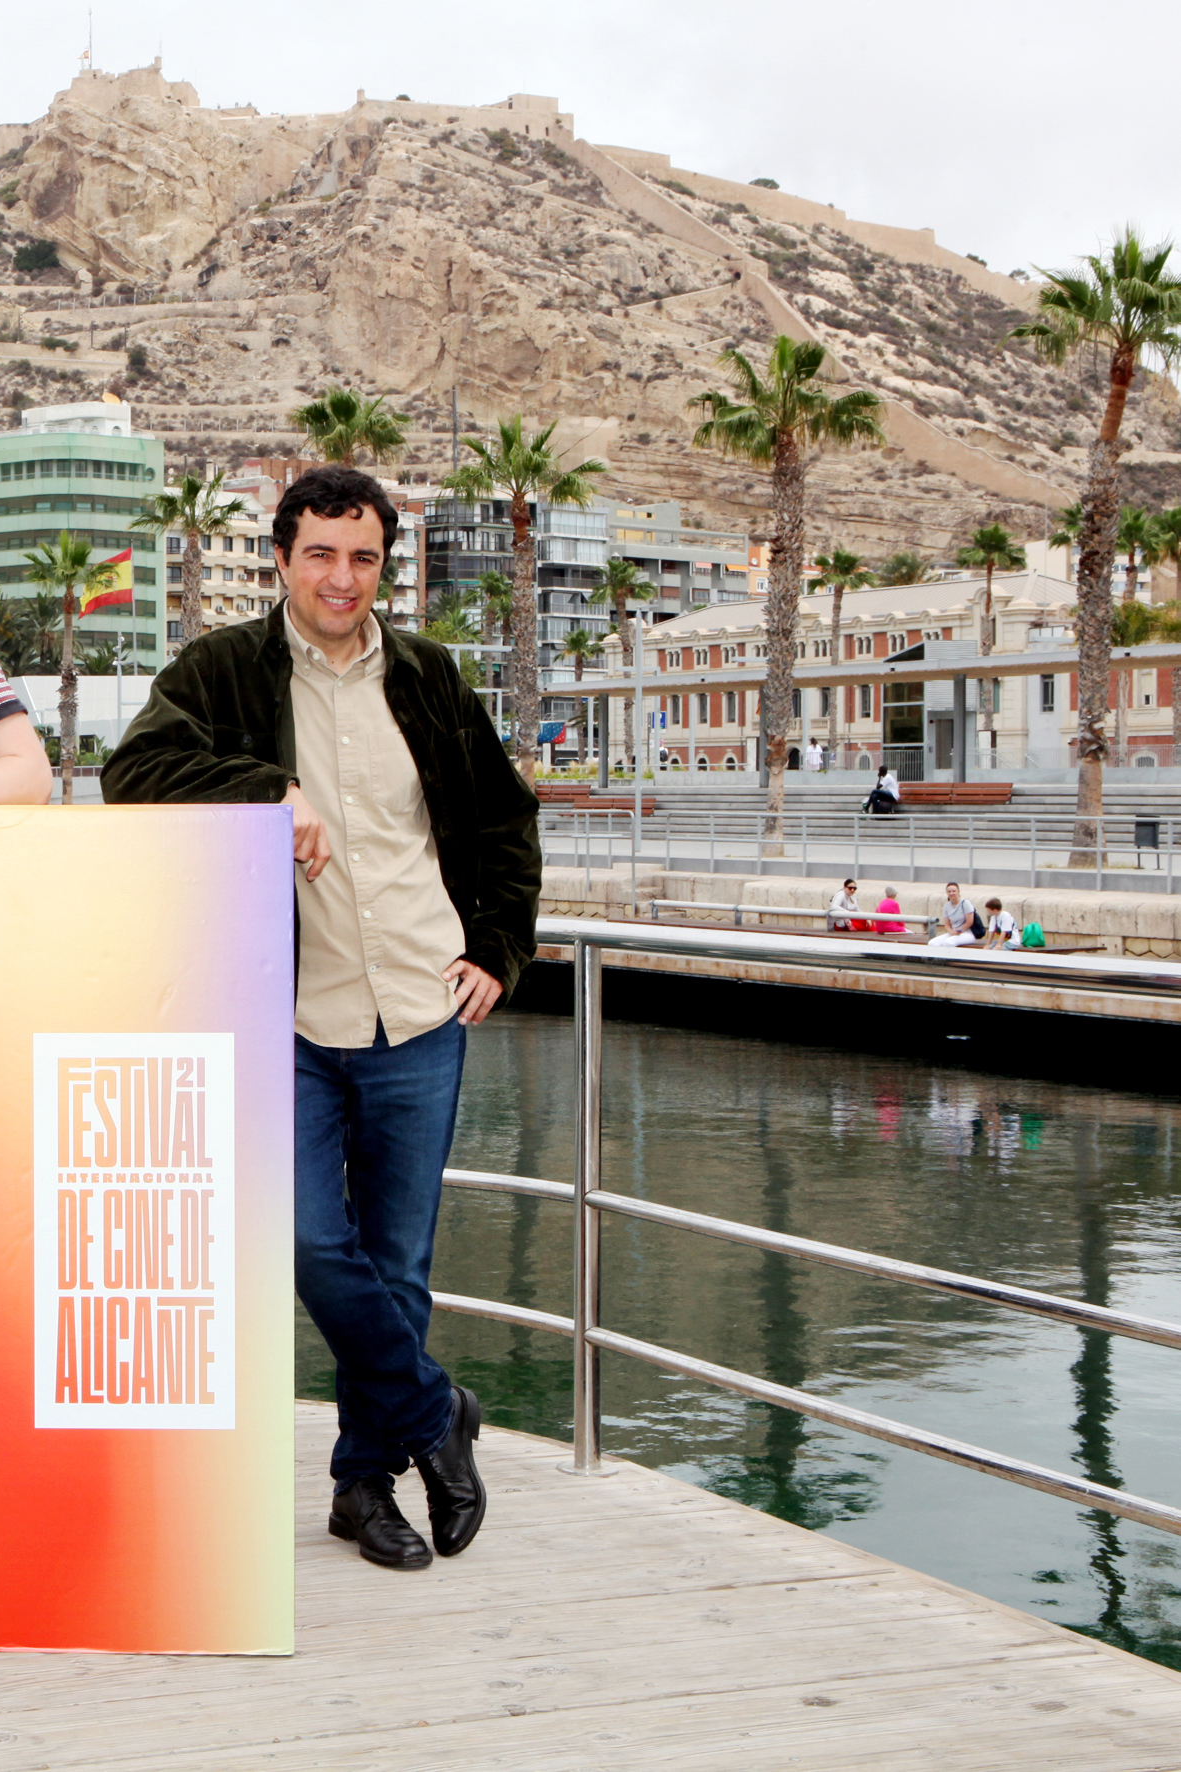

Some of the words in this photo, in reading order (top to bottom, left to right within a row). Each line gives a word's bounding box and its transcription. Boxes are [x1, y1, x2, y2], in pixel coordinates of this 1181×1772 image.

[57, 1057, 213, 1168] FESTIVAL
[57, 1172, 214, 1183] INTERNACIONAL
[57, 1189, 94, 1290] DE
[103, 1189, 174, 1290] CINE
[180, 1189, 215, 1290] DE
[55, 1296, 215, 1404] ALICANTE
